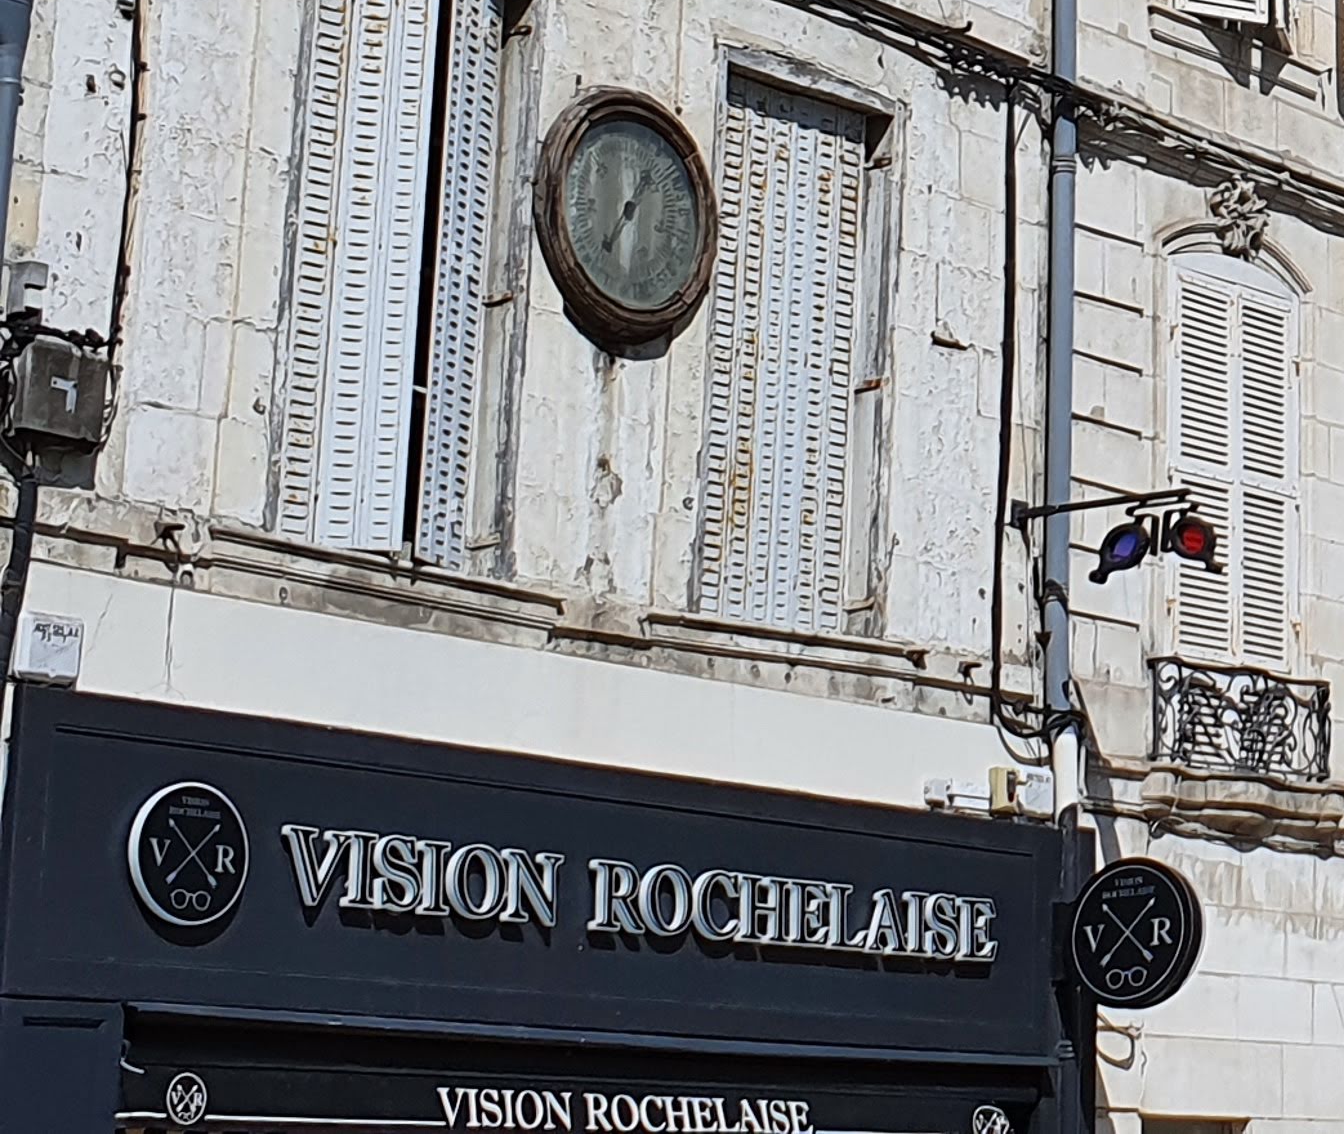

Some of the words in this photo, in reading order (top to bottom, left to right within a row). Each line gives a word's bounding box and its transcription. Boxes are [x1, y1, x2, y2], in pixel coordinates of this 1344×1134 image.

[280, 823, 565, 928] VISION
[586, 859, 999, 963] ROCHELAISE
[436, 1087, 572, 1130] VISION
[582, 1092, 814, 1134] ROCHELAISE
